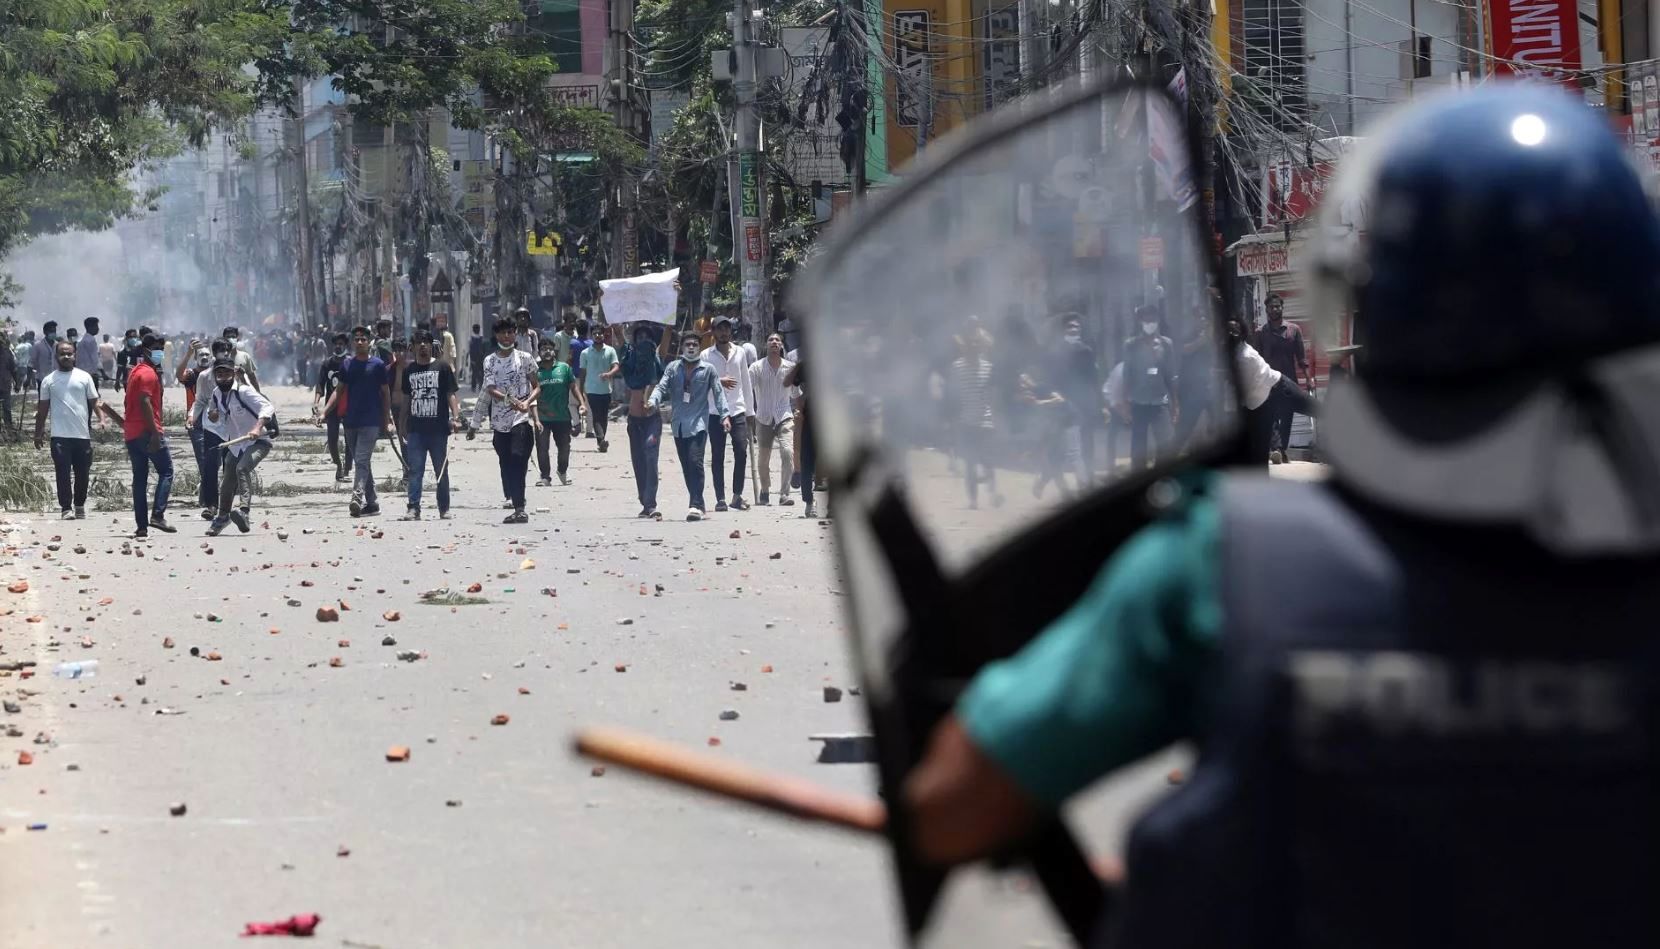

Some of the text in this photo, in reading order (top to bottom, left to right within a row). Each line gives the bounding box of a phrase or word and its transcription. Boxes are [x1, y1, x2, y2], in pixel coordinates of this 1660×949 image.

[1509, 0, 1565, 81] NITUR
[408, 370, 440, 389] SYSTEM
[427, 388, 439, 399] A
[411, 398, 439, 416] DOWN
